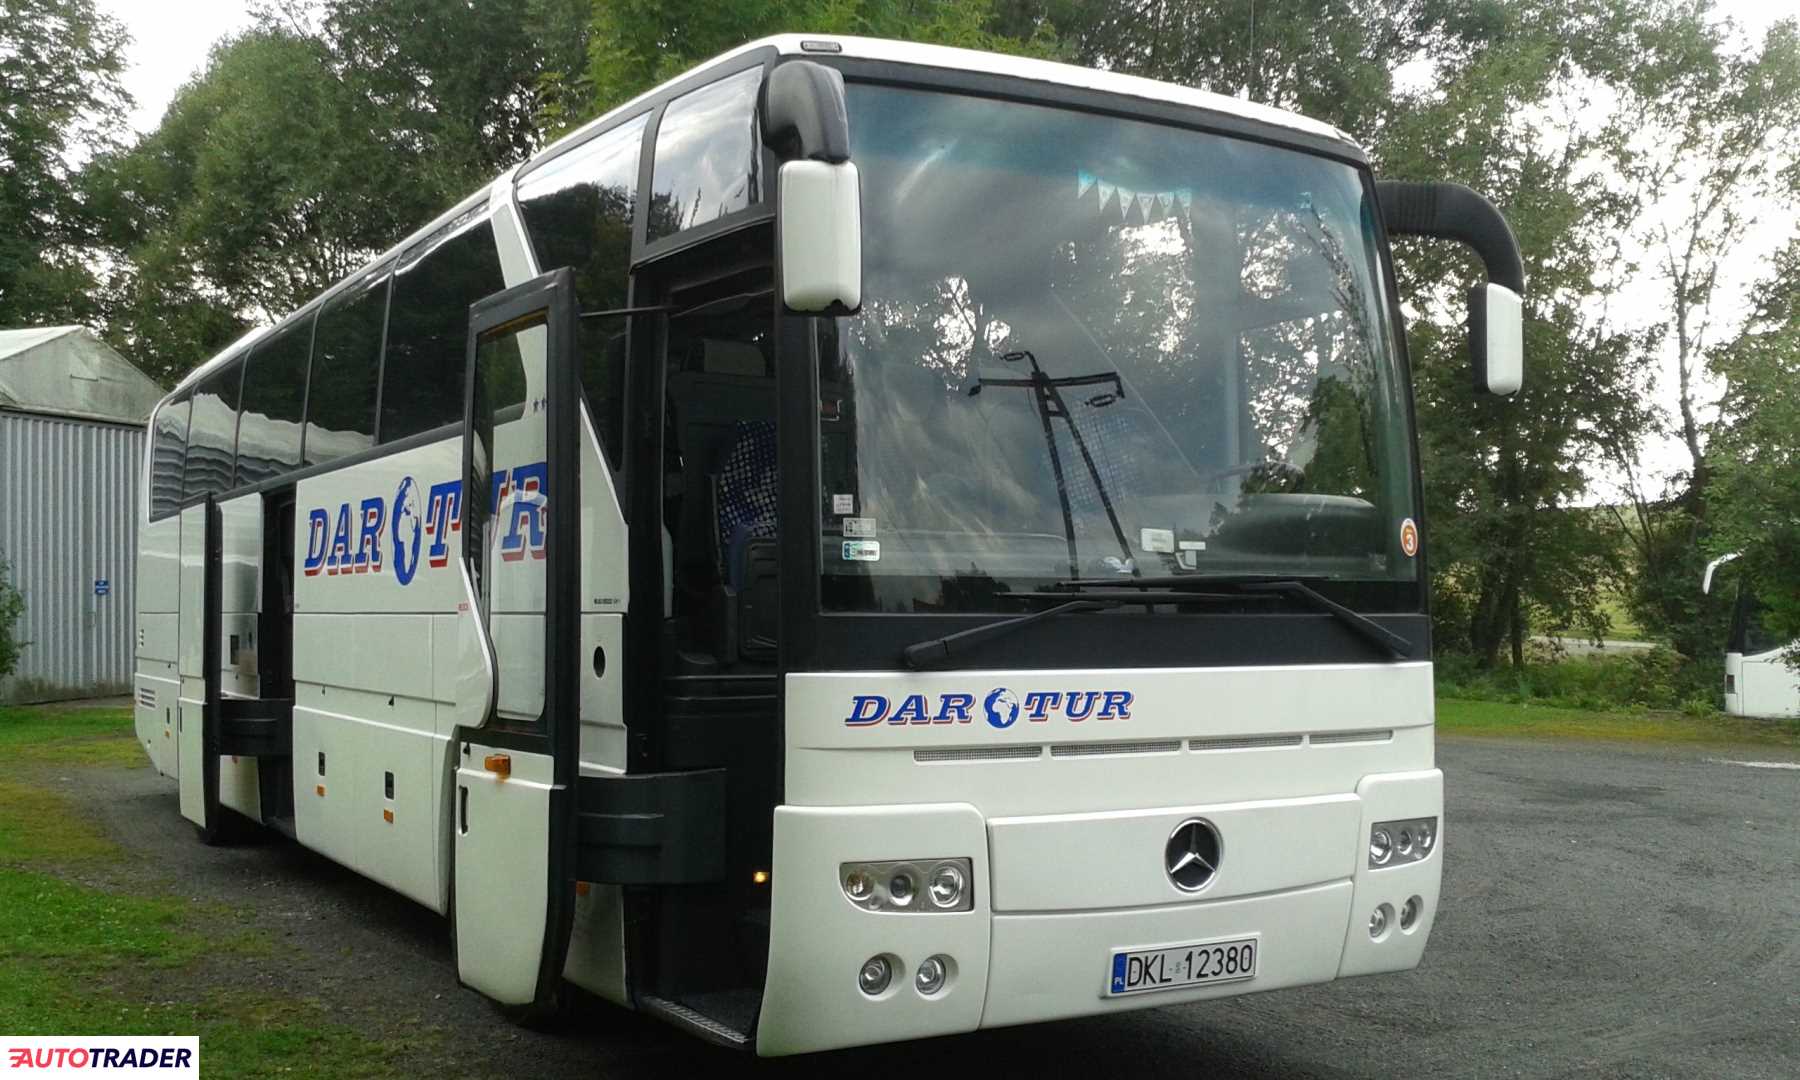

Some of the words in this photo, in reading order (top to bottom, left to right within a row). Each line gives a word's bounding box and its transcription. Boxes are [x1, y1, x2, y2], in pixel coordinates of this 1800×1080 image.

[1406, 534, 1415, 551] 3
[1127, 953, 1172, 987] DKL
[1184, 944, 1254, 980] 12380
[1113, 977, 1124, 985] PL
